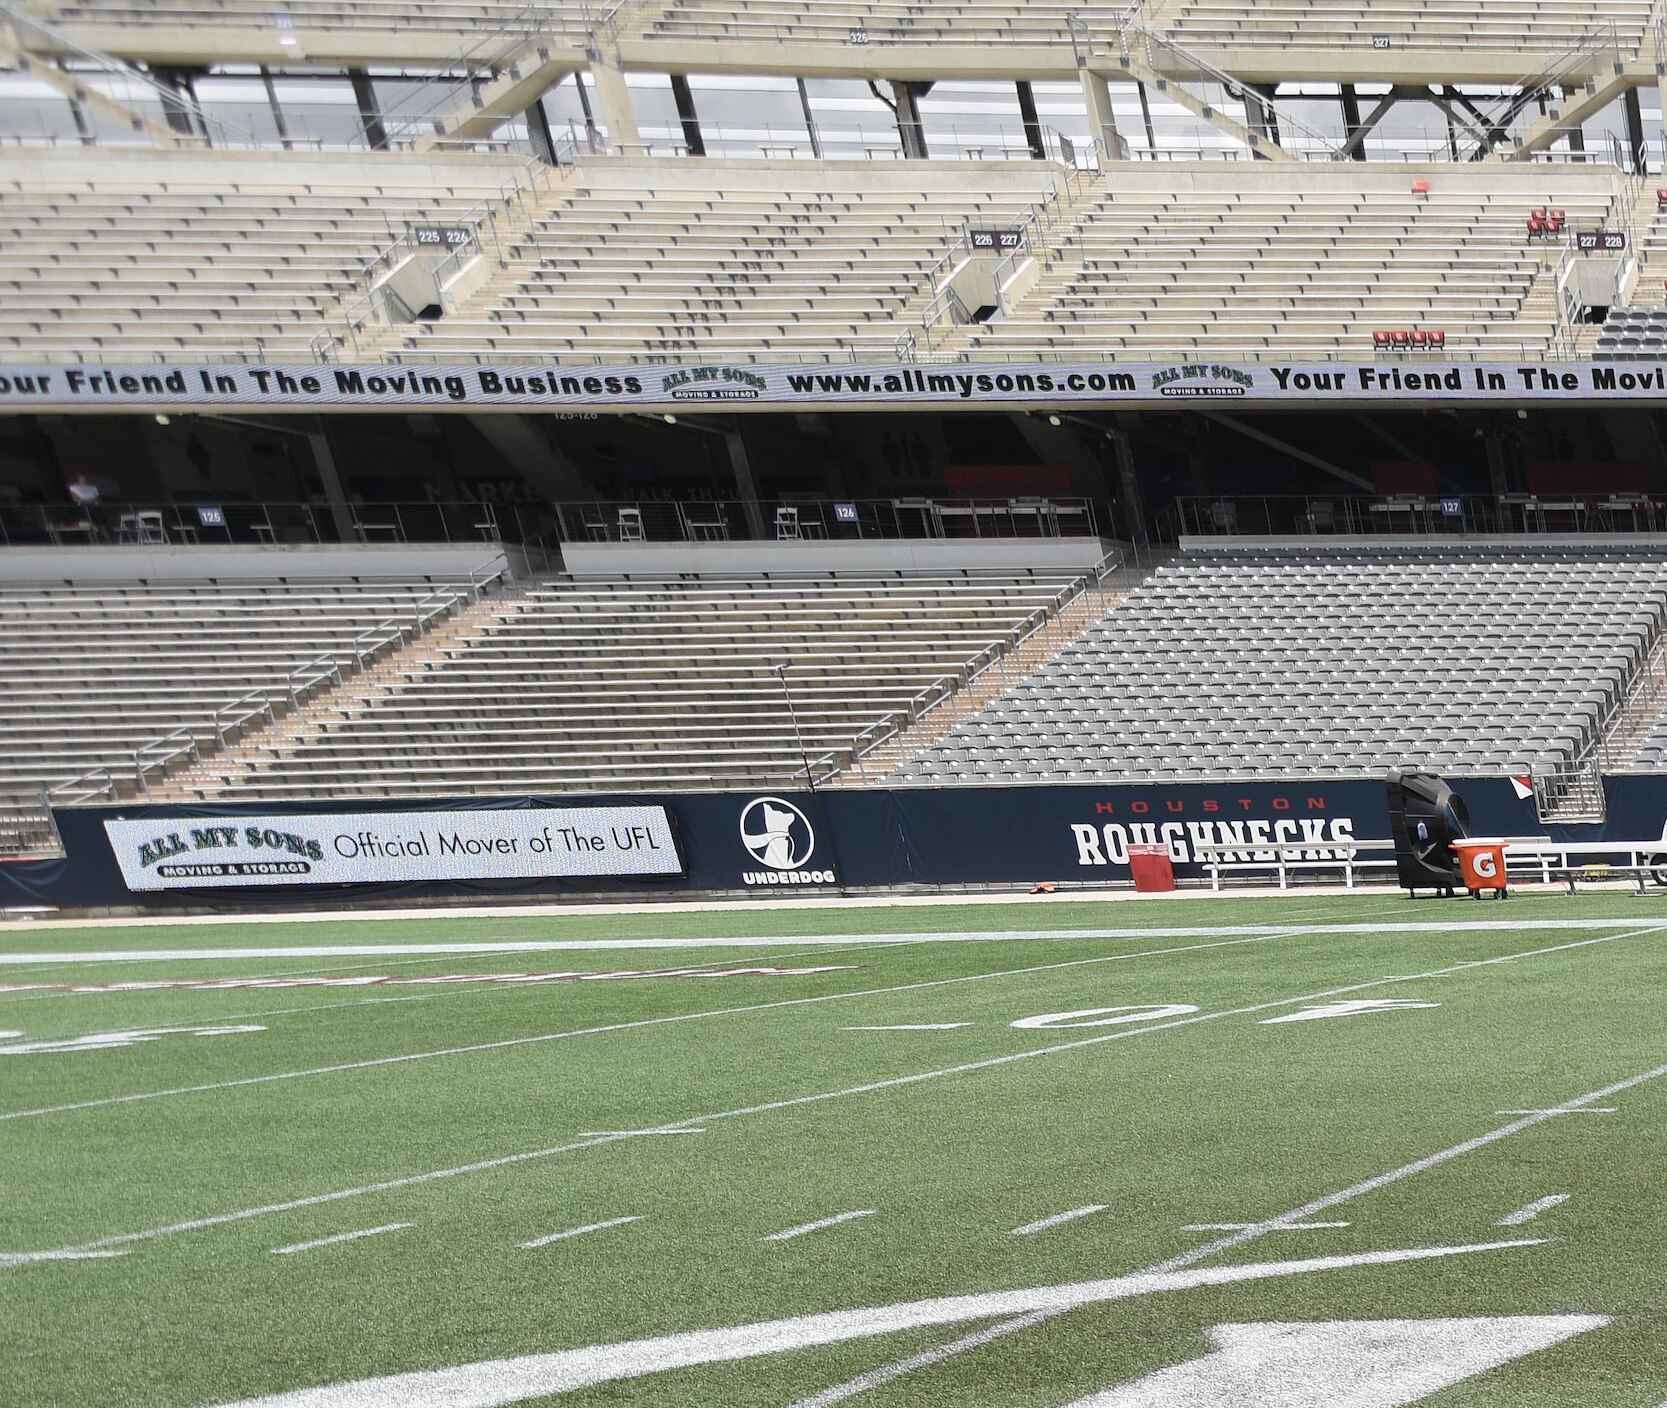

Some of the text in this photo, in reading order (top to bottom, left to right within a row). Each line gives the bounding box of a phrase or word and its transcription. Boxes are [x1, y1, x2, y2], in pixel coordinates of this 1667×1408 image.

[850, 31, 868, 43] 326
[1373, 37, 1389, 48] 327
[419, 231, 468, 242] 225 226
[975, 233, 1018, 245] 226 227
[1581, 236, 1622, 247] 227 228
[663, 367, 767, 391] ALL MY SONS
[787, 370, 1136, 397] www.allmysons.com
[1153, 365, 1253, 390] ALL MY SONS
[1270, 368, 1346, 391] Your
[1359, 368, 1461, 391] Friend
[1476, 368, 1505, 390] In
[1518, 368, 1578, 391] The
[65, 370, 187, 394] Friend
[199, 370, 238, 394] In
[248, 370, 321, 394] The
[334, 371, 466, 400] Moving
[478, 371, 642, 394] Business
[1207, 388, 1242, 396] STORAGE
[837, 507, 854, 518] 126
[1443, 503, 1459, 512] 127
[202, 512, 221, 523] 125
[1094, 796, 1326, 815] HOUSTON
[138, 826, 661, 868] ALL MY SONS Official Mover of The UFL
[1070, 817, 1360, 866] ROUGHNECKS
[163, 862, 307, 877] MOVING & STORAGE
[1472, 852, 1496, 878] G
[742, 870, 836, 884] UNDERDOG
